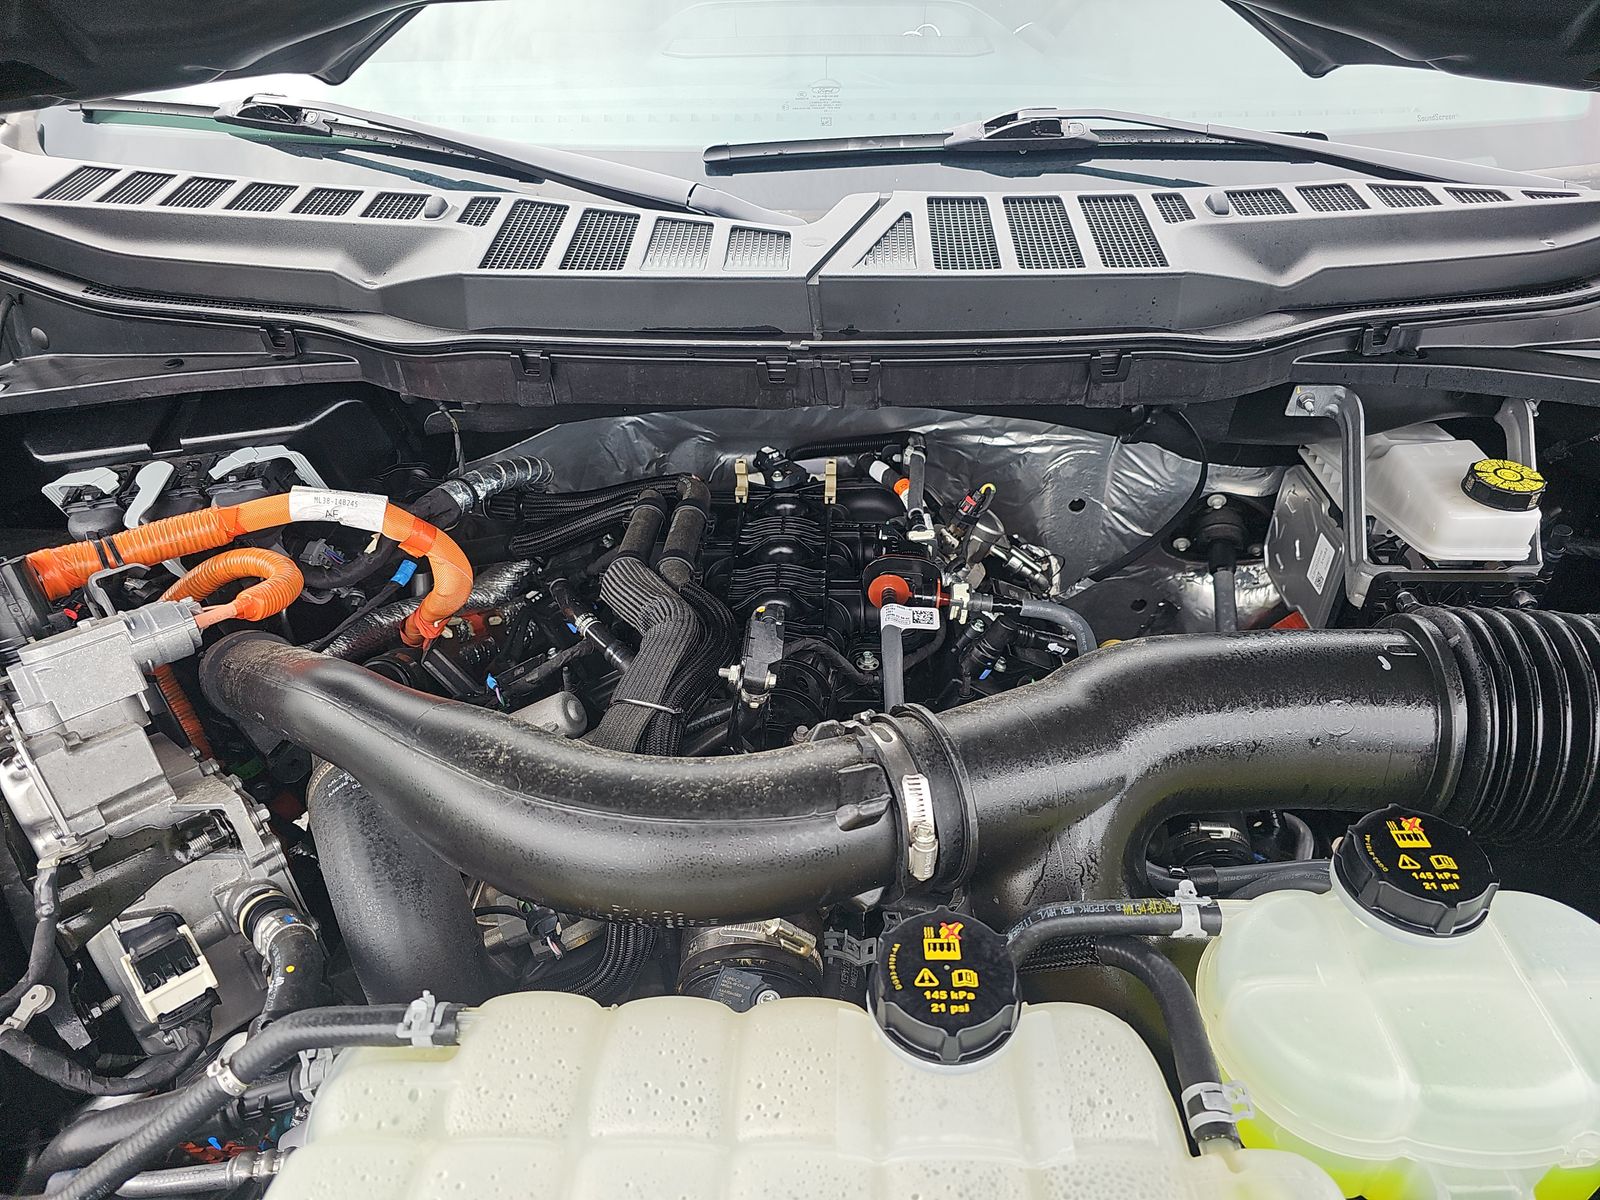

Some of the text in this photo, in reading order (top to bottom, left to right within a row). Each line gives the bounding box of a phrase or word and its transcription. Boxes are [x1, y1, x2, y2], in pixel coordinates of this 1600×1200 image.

[1417, 113, 1456, 122] SoundScreen
[1411, 871, 1460, 880] 145 kPa
[1422, 882, 1460, 892] 21 psi
[923, 990, 976, 1000] 145 kPa
[930, 1003, 970, 1015] 21 psi
